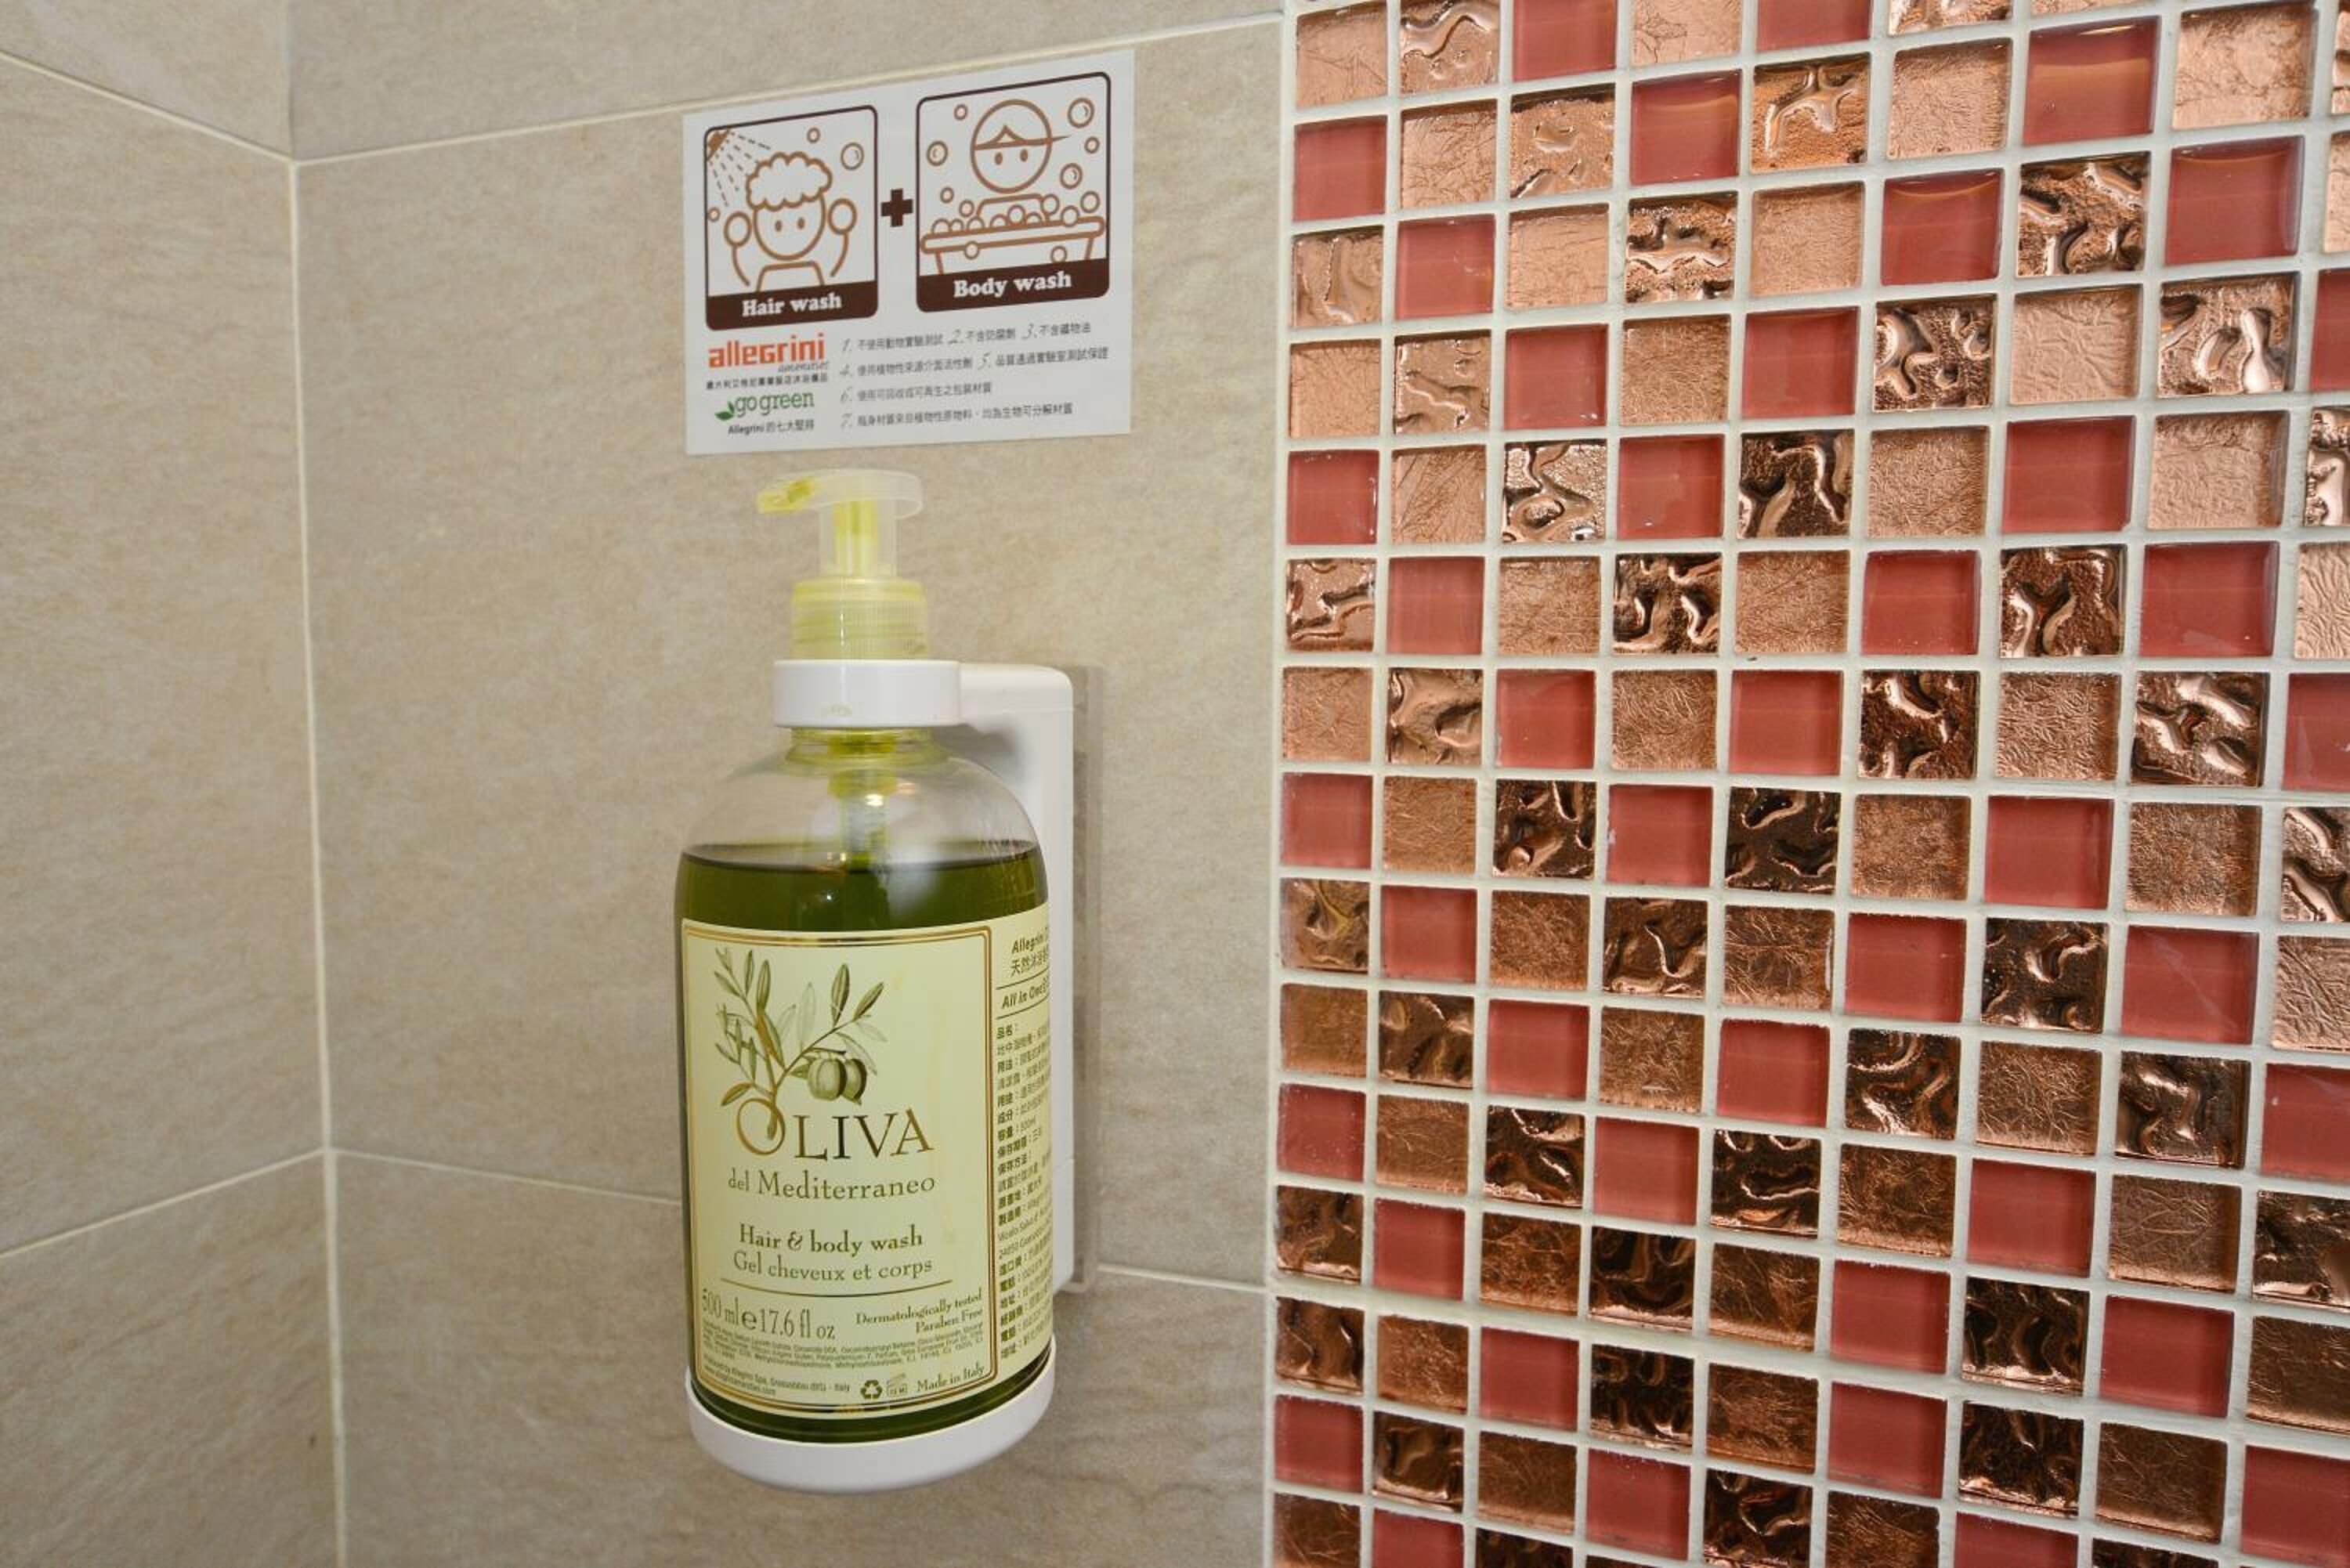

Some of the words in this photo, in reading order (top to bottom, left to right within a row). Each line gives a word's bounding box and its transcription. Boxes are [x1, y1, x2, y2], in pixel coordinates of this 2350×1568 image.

[953, 277, 1007, 299] Body
[1014, 270, 1072, 292] wash
[742, 298, 785, 316] Hair
[790, 292, 843, 313] wash
[736, 1097, 935, 1162] OLIVA
[728, 1167, 750, 1191] del
[757, 1169, 935, 1200] Mediterraneo
[739, 1221, 781, 1250] Hair
[787, 1230, 803, 1252] &
[810, 1229, 862, 1258] body
[871, 1223, 923, 1251] wash
[733, 1249, 762, 1275] Gel
[767, 1254, 846, 1282] cheveux
[852, 1263, 871, 1281] et
[878, 1259, 934, 1280] corps
[855, 1298, 953, 1325] Dermatologically
[955, 1287, 982, 1308] tested
[916, 1315, 960, 1333] Paraben
[961, 1309, 983, 1322] Free
[761, 1308, 795, 1338] 17.6
[800, 1308, 811, 1339] fl
[816, 1325, 836, 1339] oz
[916, 1373, 948, 1393] Made
[949, 1372, 961, 1384] in
[963, 1361, 985, 1381] Italy
